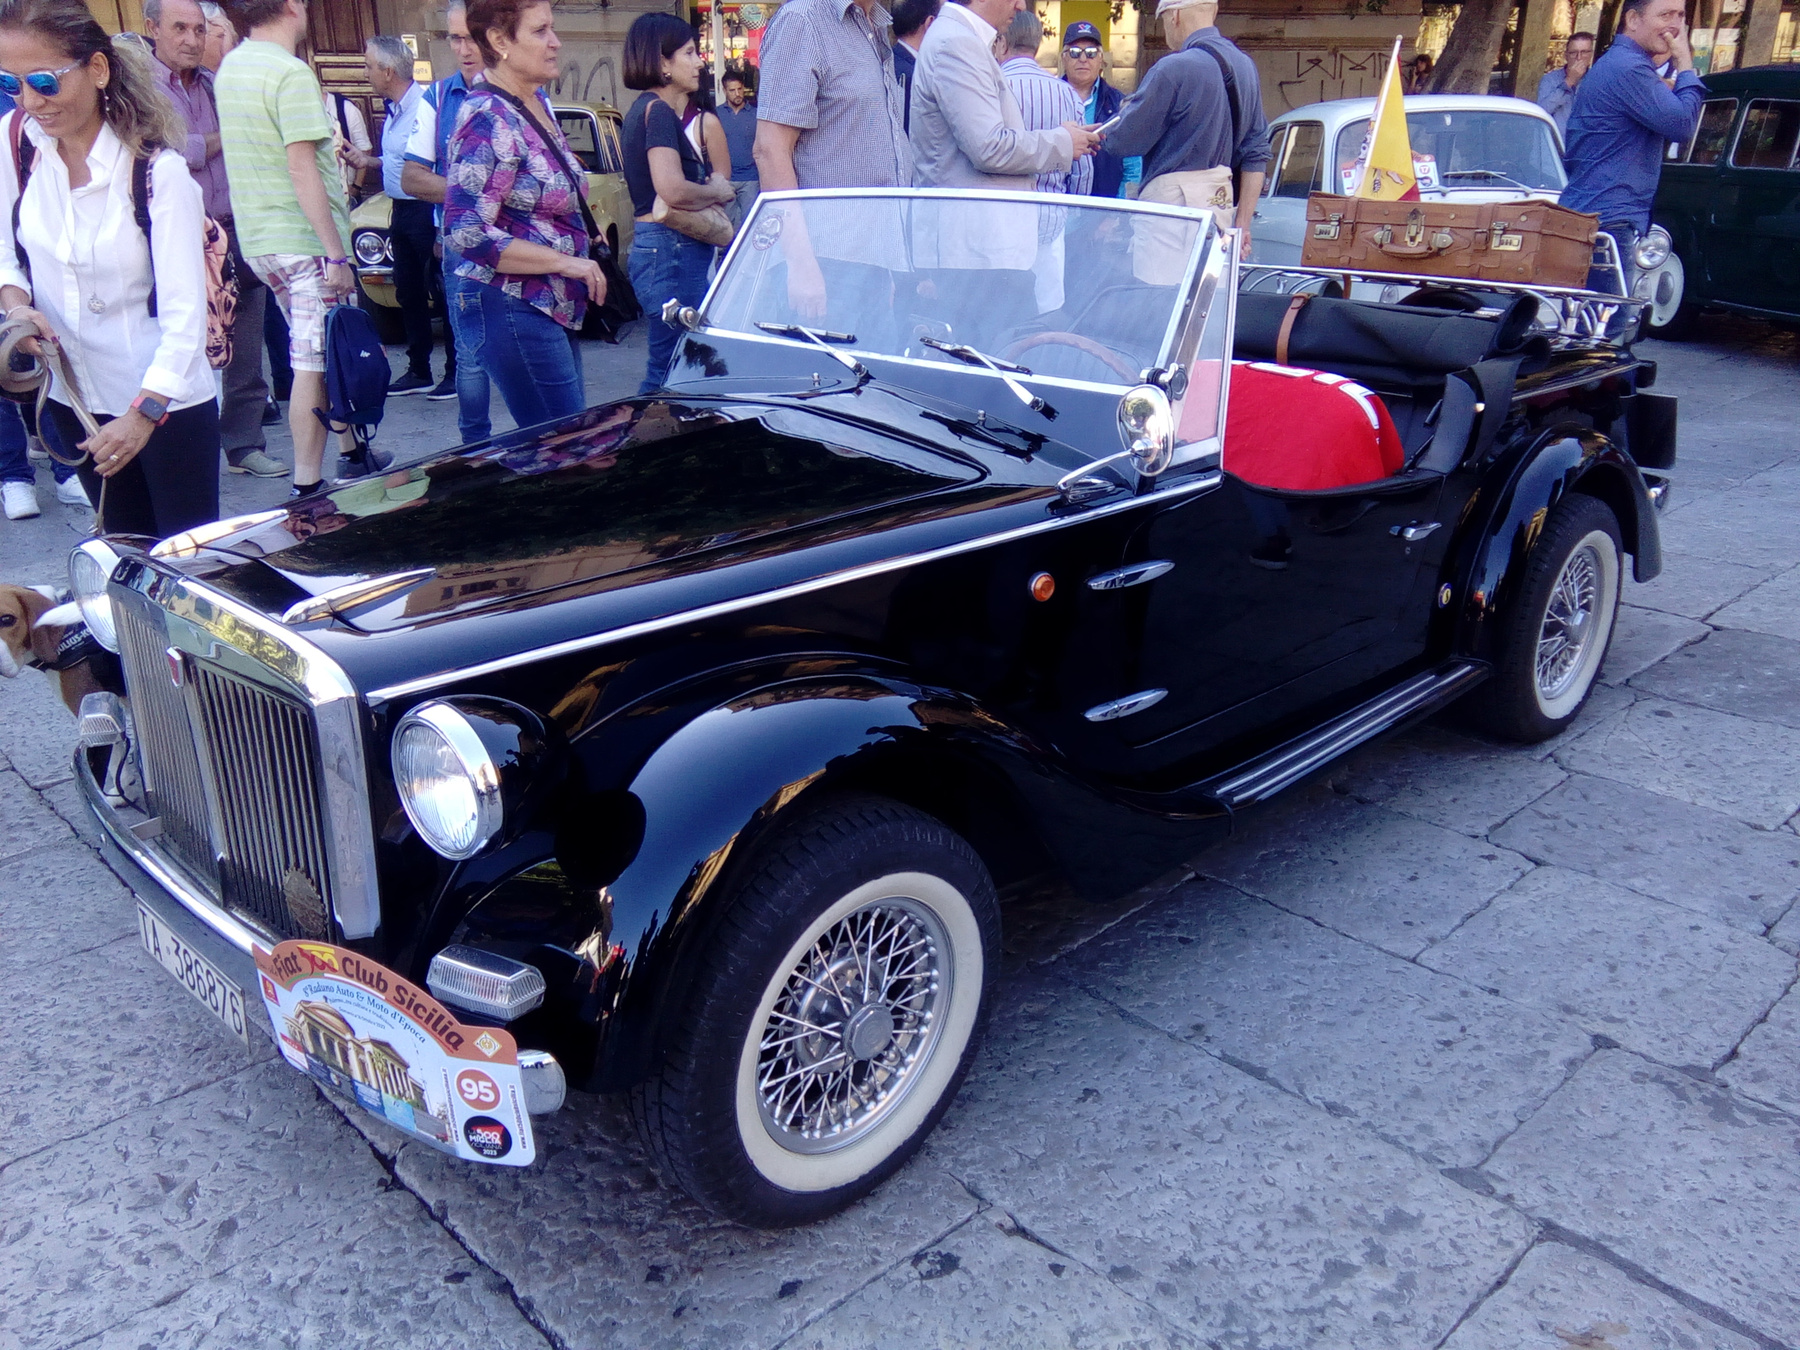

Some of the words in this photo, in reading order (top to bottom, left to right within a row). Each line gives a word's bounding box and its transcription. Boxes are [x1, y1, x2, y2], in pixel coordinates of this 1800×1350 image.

[138, 906, 163, 962] TA
[171, 936, 243, 1035] 386876
[273, 951, 303, 981] Fiat
[341, 956, 389, 993] Club
[393, 984, 465, 1051] Sicilia
[336, 985, 356, 999] Auto
[356, 991, 365, 1002] &
[367, 996, 390, 1015] Moto
[391, 1012, 427, 1044] d'Epoca
[460, 1078, 496, 1103] 95
[468, 1134, 502, 1145] MIGLIA
